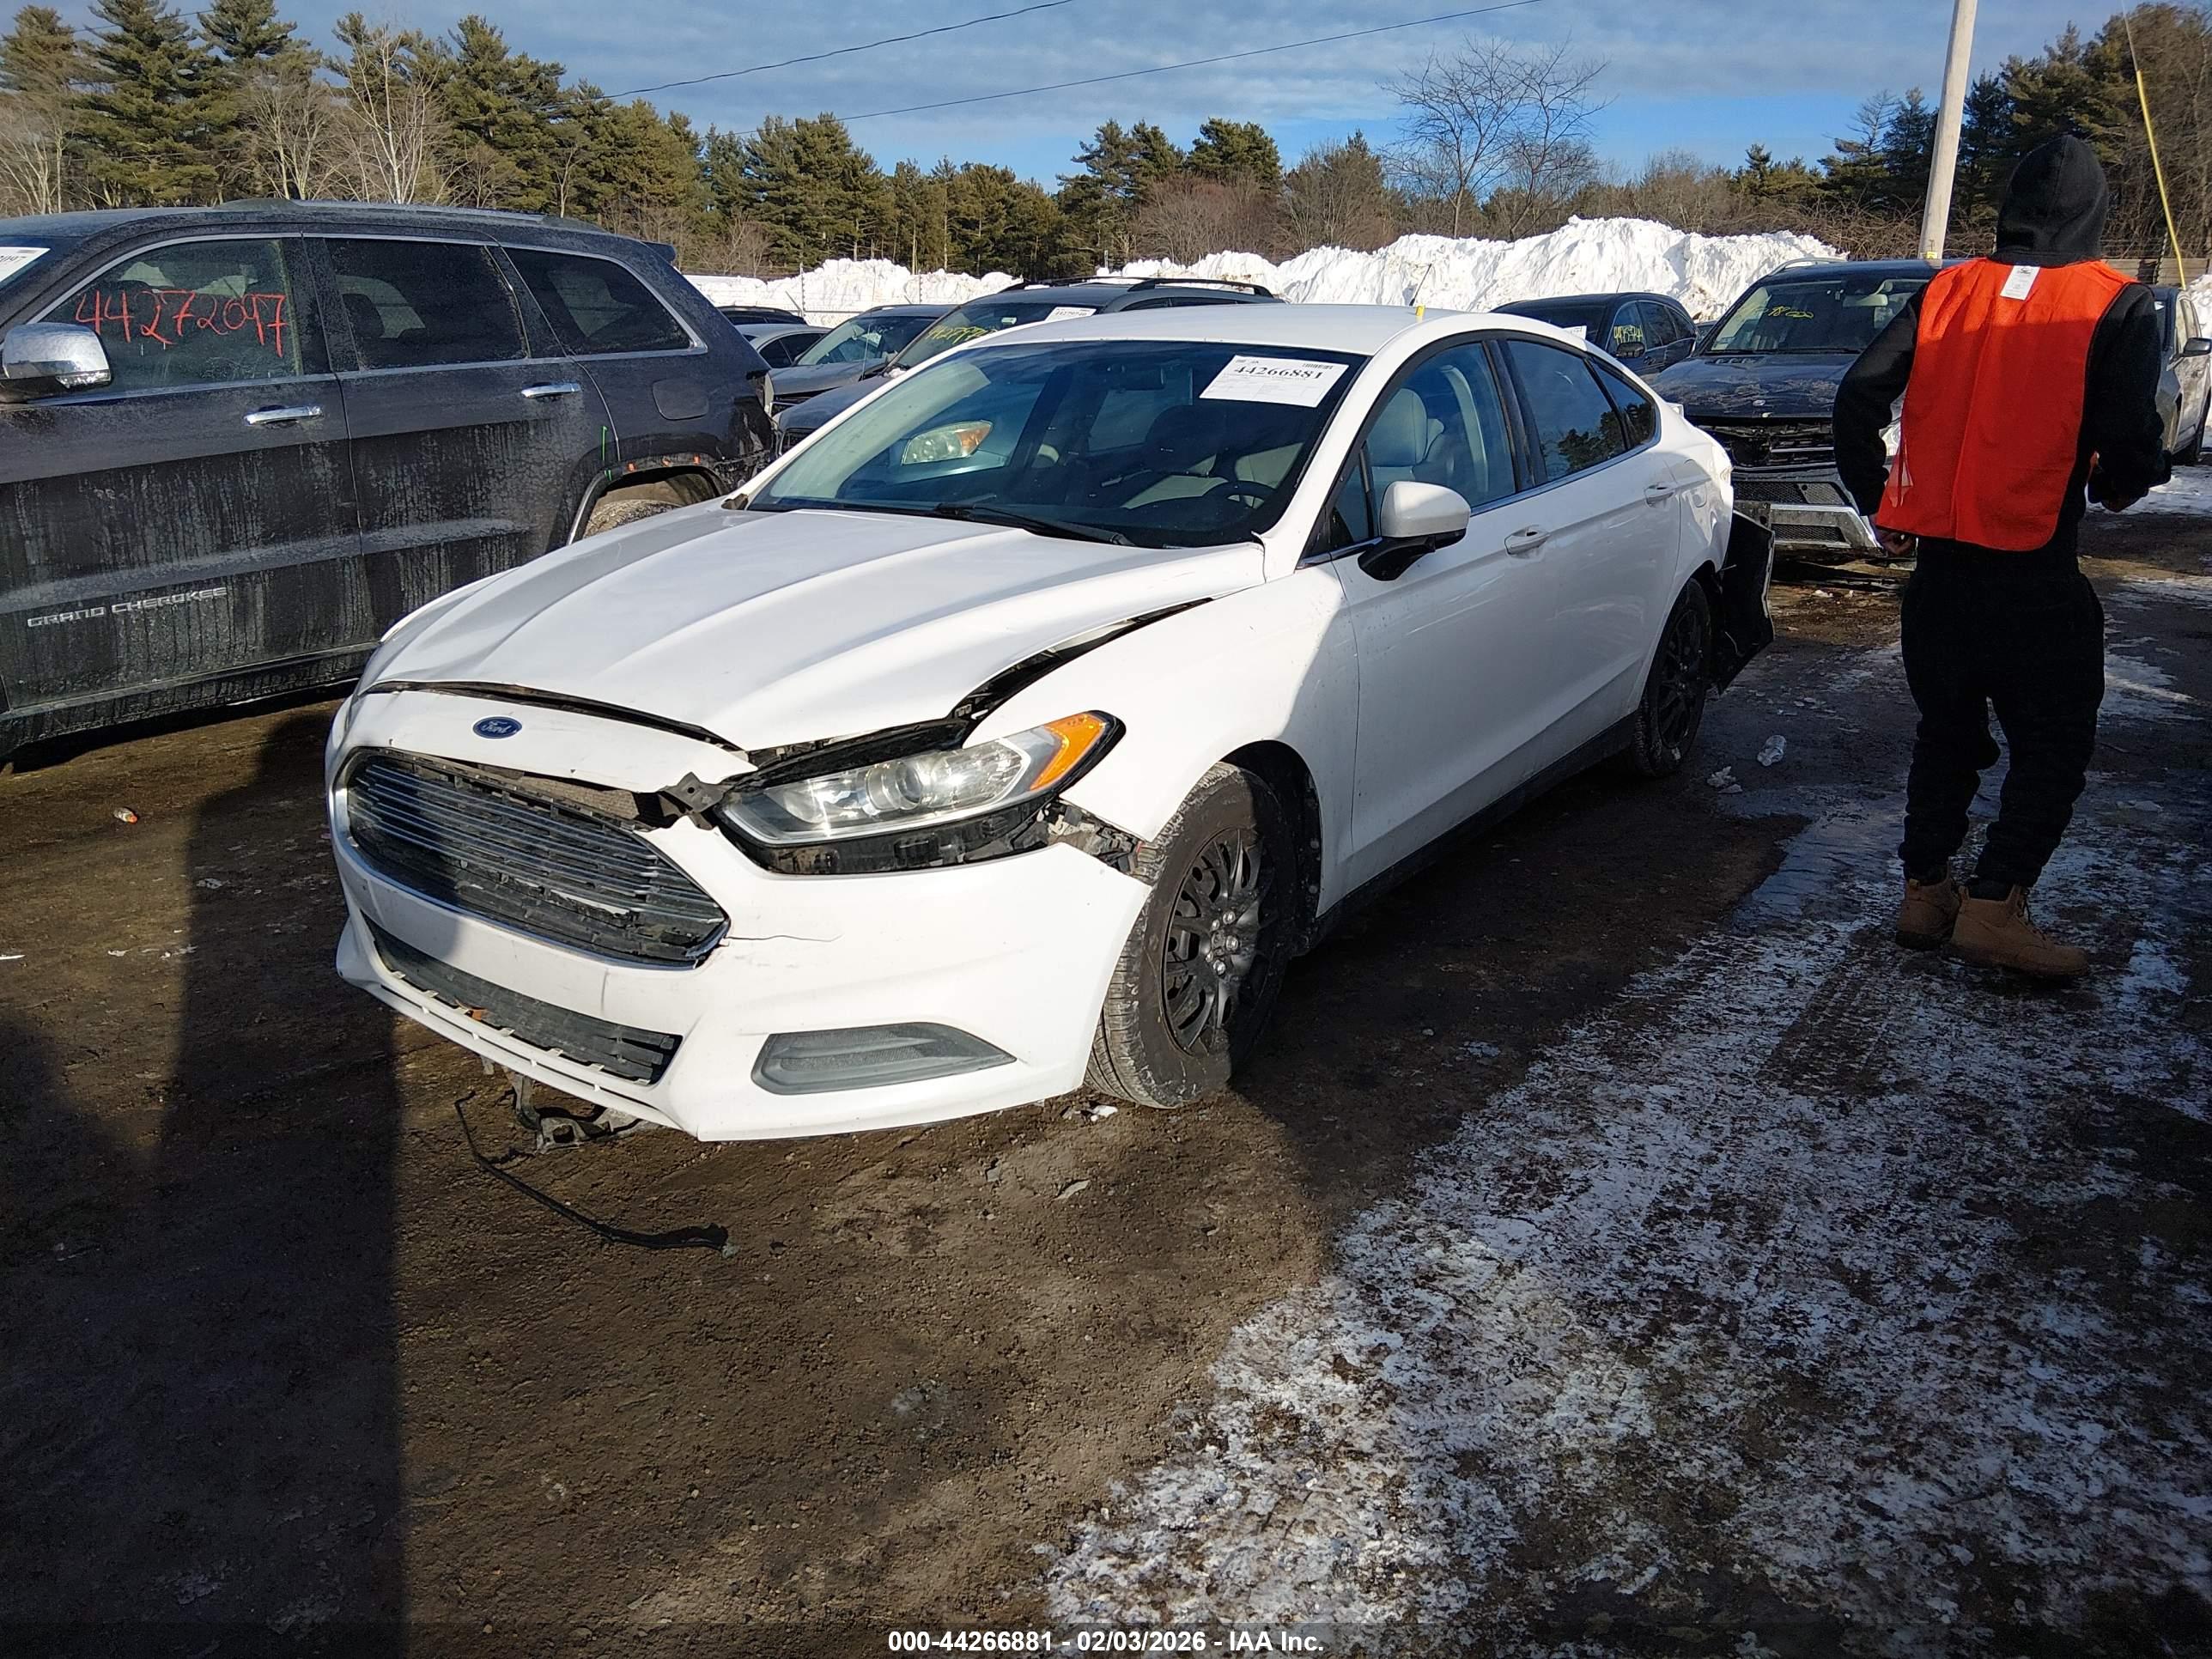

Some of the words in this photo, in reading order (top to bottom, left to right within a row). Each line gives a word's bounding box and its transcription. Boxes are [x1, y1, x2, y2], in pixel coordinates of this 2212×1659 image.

[76, 289, 287, 358] 44272097
[1234, 365, 1323, 380] 44266881
[27, 606, 105, 628] GRAND
[112, 587, 228, 613] CHEROKEE
